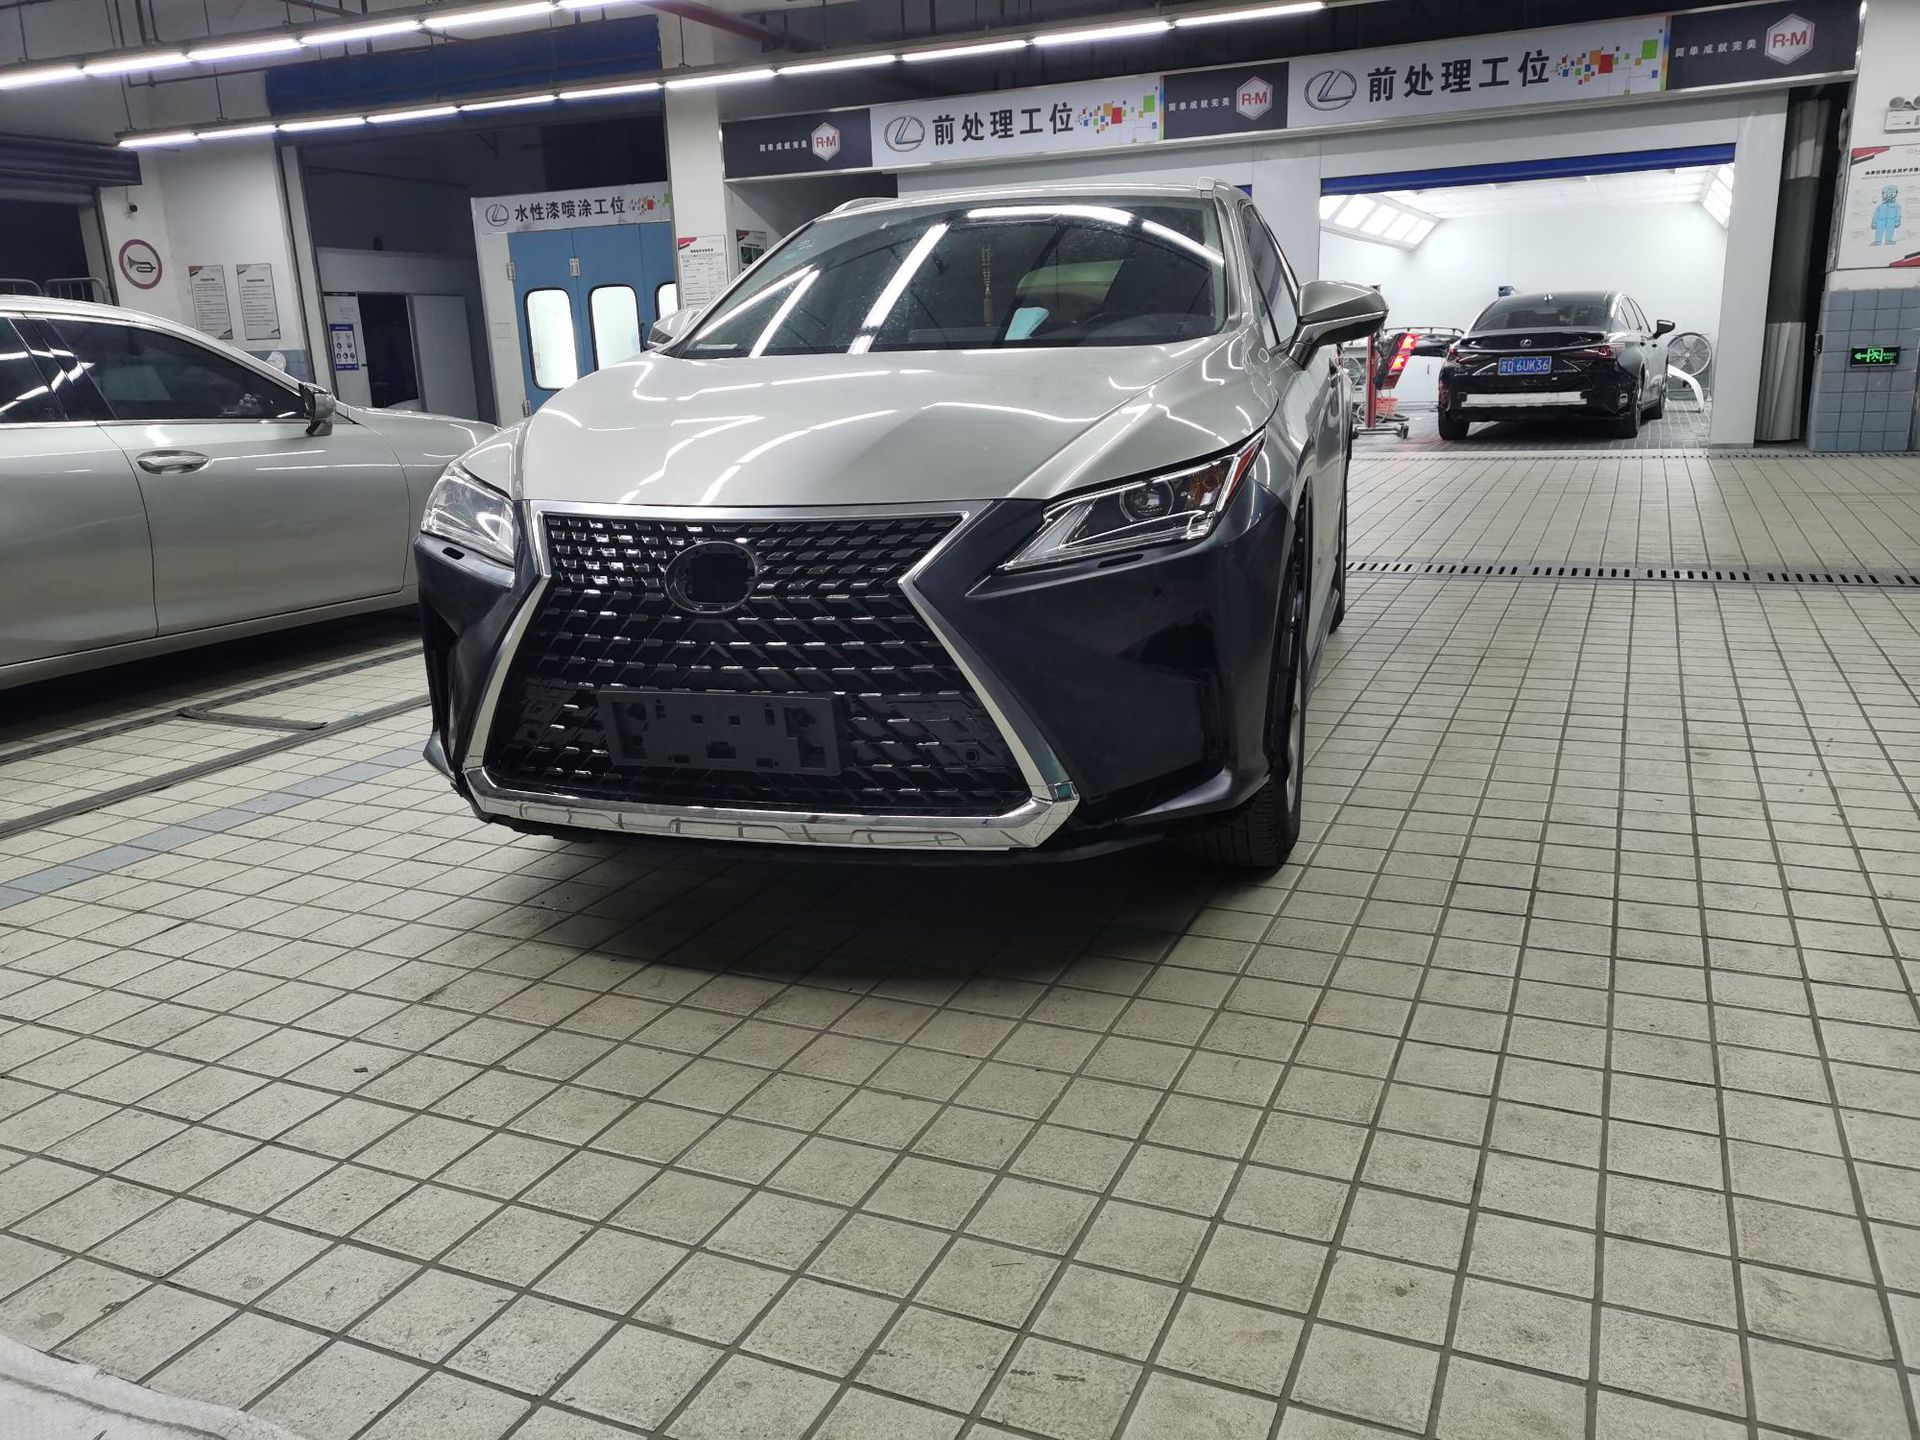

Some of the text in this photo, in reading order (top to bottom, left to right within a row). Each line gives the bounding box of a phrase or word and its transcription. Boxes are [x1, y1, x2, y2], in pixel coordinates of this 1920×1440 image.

[1772, 30, 1807, 48] R-M
[1367, 49, 1550, 102] 前处理工位
[932, 102, 1074, 146] 前处理工位
[514, 196, 626, 222] 水性漆喷涂工位
